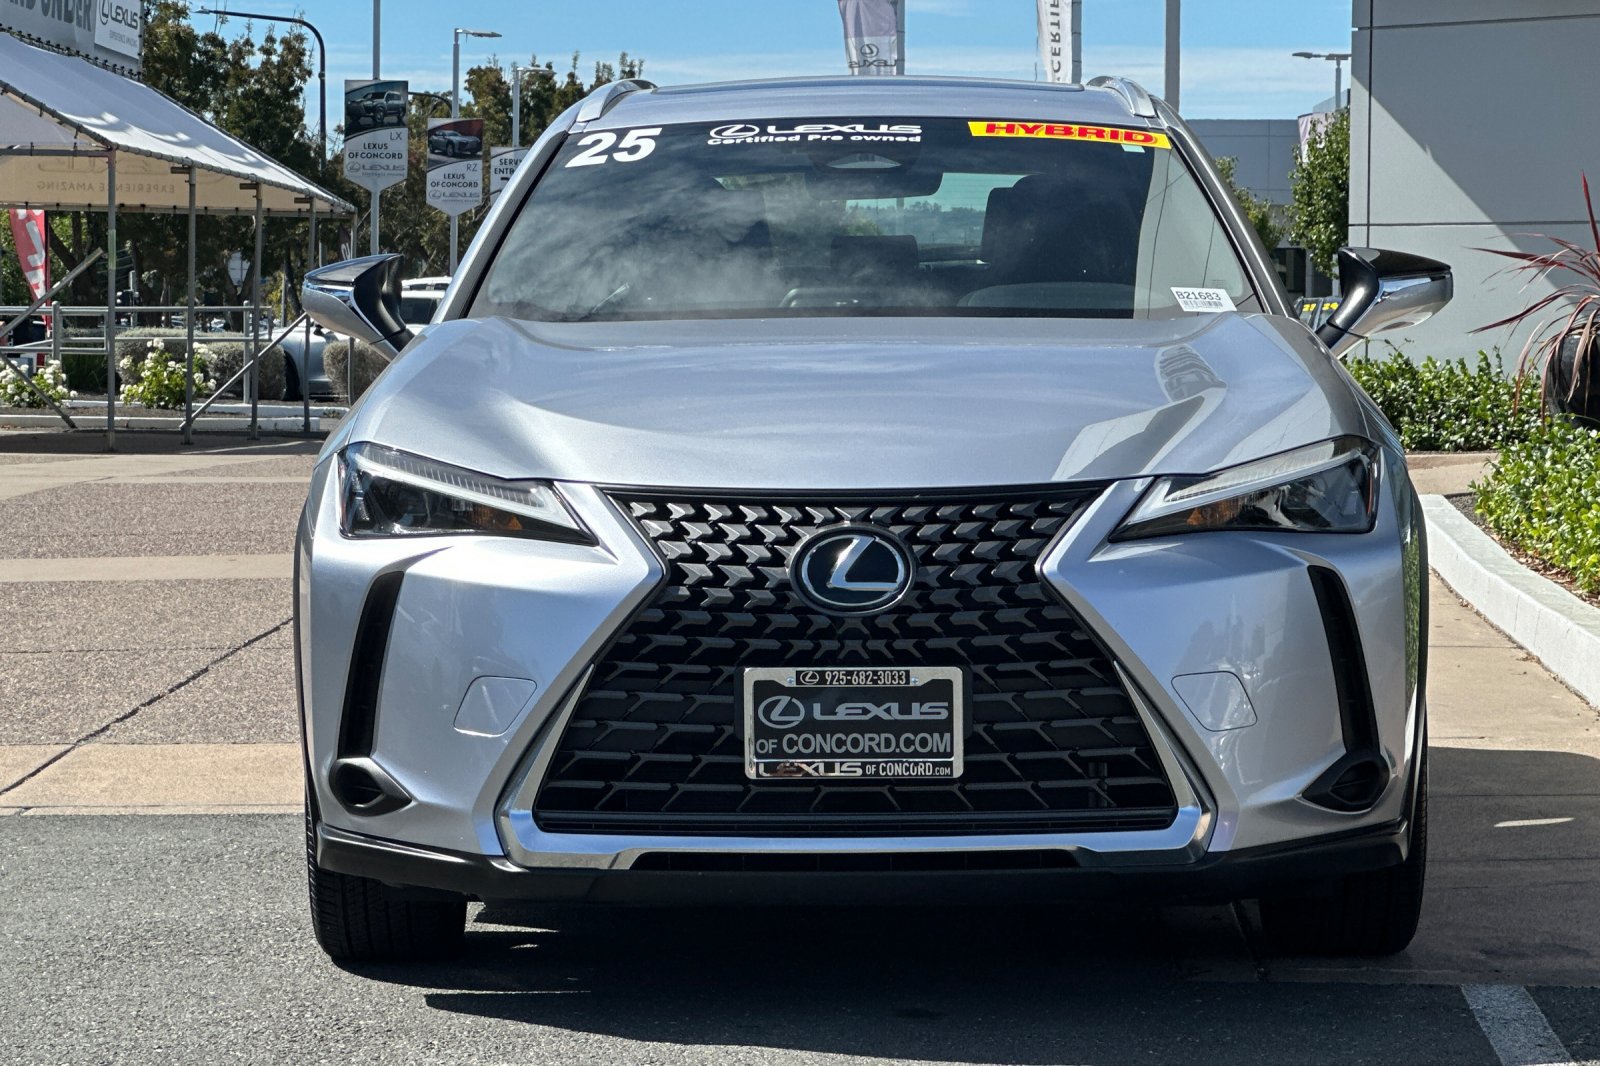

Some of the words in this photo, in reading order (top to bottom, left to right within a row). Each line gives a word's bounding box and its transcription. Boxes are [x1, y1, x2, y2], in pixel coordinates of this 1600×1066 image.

[110, 2, 138, 30] LEXUS
[767, 123, 923, 135] LEXUS
[985, 122, 1157, 145] HYBRID
[390, 131, 402, 141] LX
[706, 134, 800, 146] Certified
[808, 133, 843, 143] Pre
[851, 133, 921, 143] owned
[363, 142, 388, 150] LEXUS
[565, 127, 662, 168] 25
[360, 152, 403, 160] CONCORD
[466, 163, 478, 172] RZ
[1175, 290, 1221, 301] B21683
[825, 670, 906, 686] 925-682-3033
[812, 702, 949, 720] LEXUS
[756, 738, 778, 754] OF
[782, 732, 951, 754] CONCORD.COM
[865, 763, 877, 775] OF
